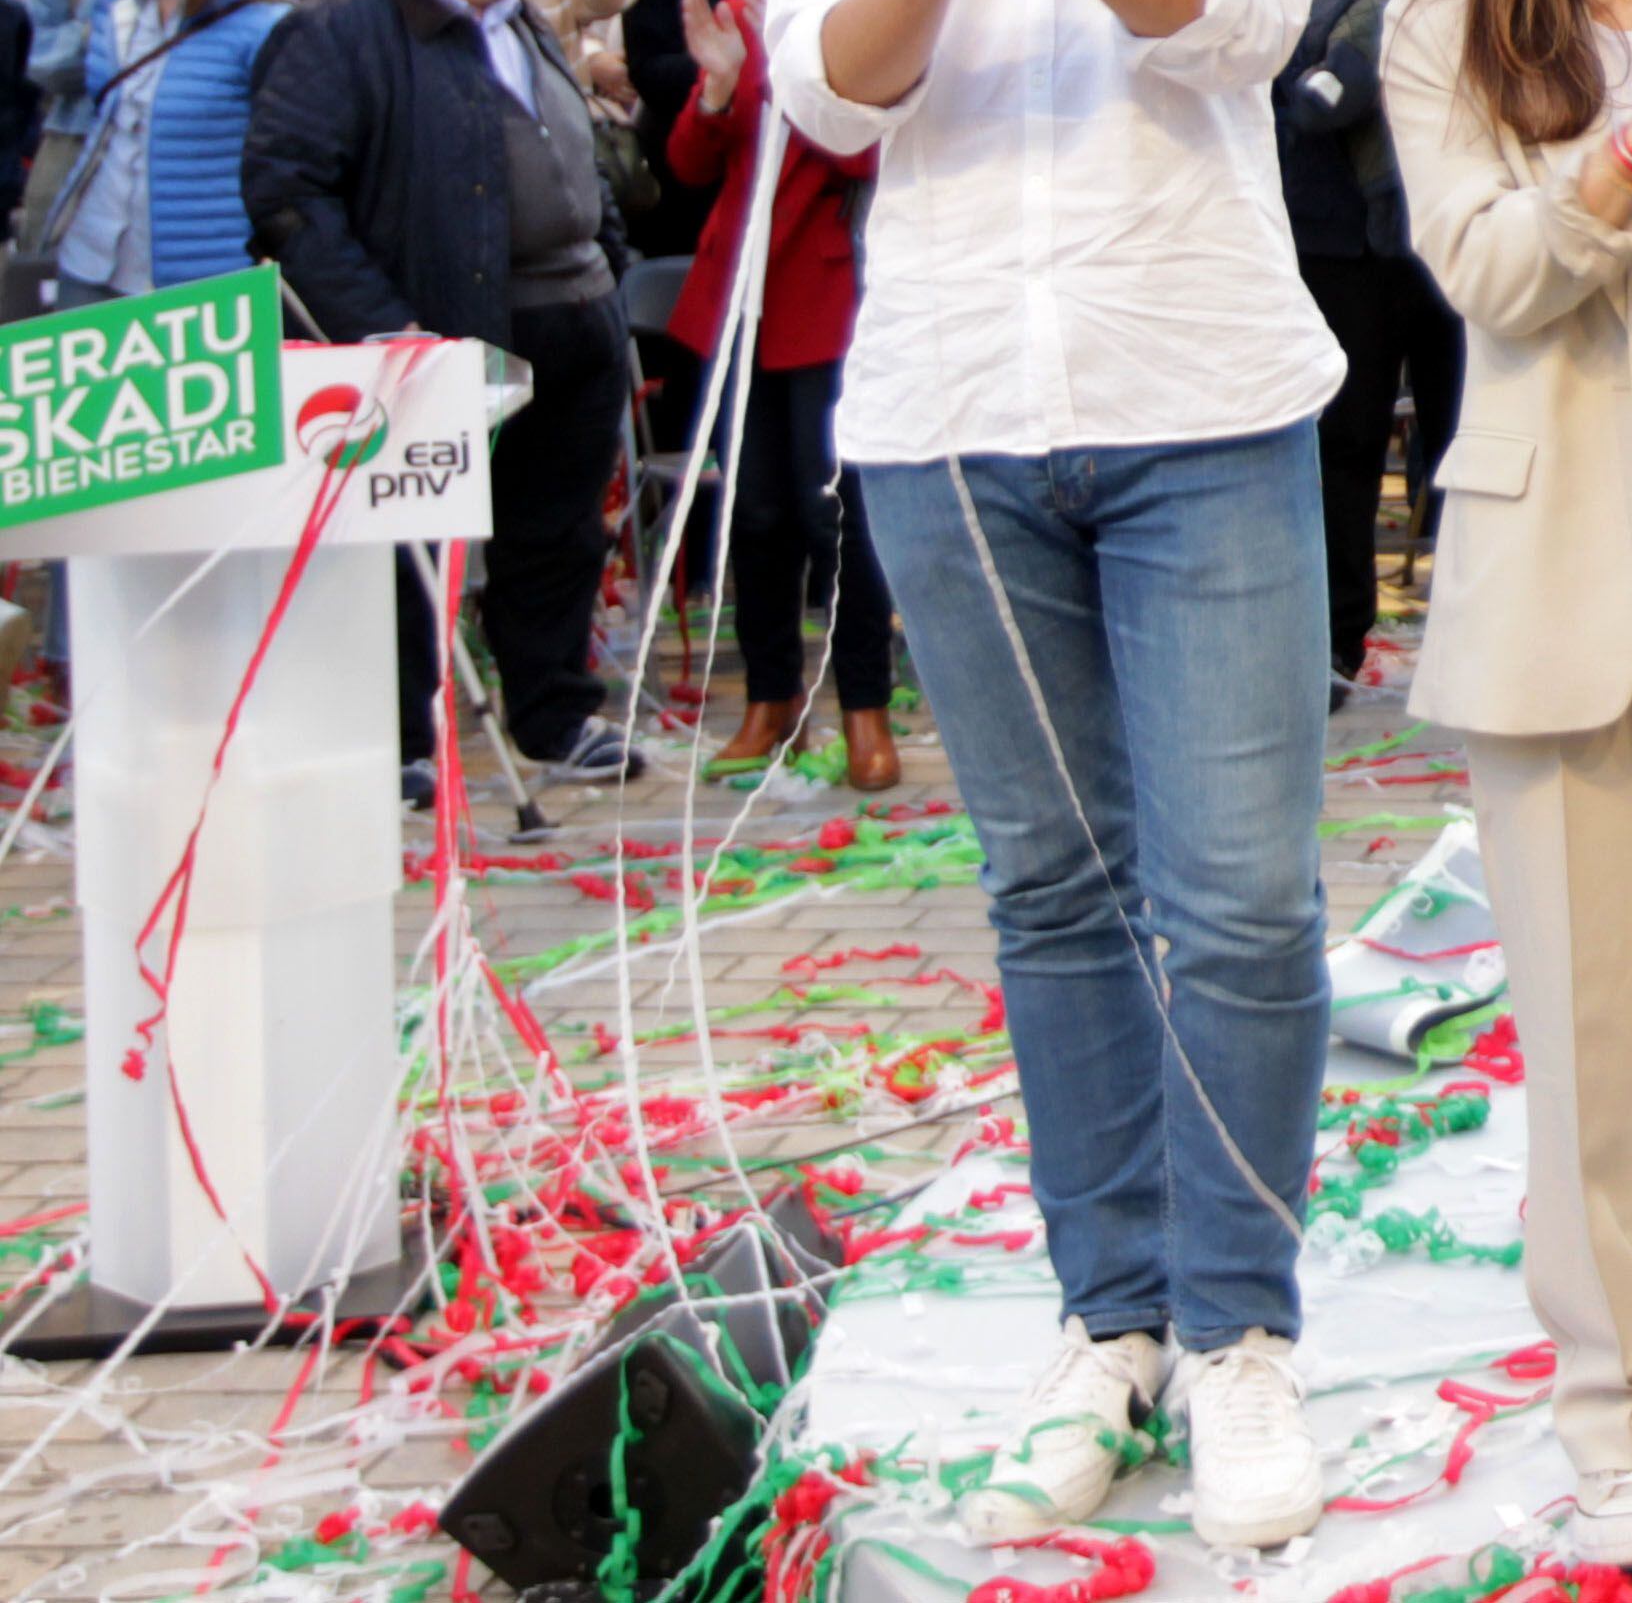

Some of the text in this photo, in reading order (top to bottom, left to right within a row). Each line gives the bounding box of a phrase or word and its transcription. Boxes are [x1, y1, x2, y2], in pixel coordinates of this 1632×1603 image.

[0, 295, 252, 398] ERATU
[3, 419, 256, 506] BIENESTAR
[370, 470, 452, 508] pnv
